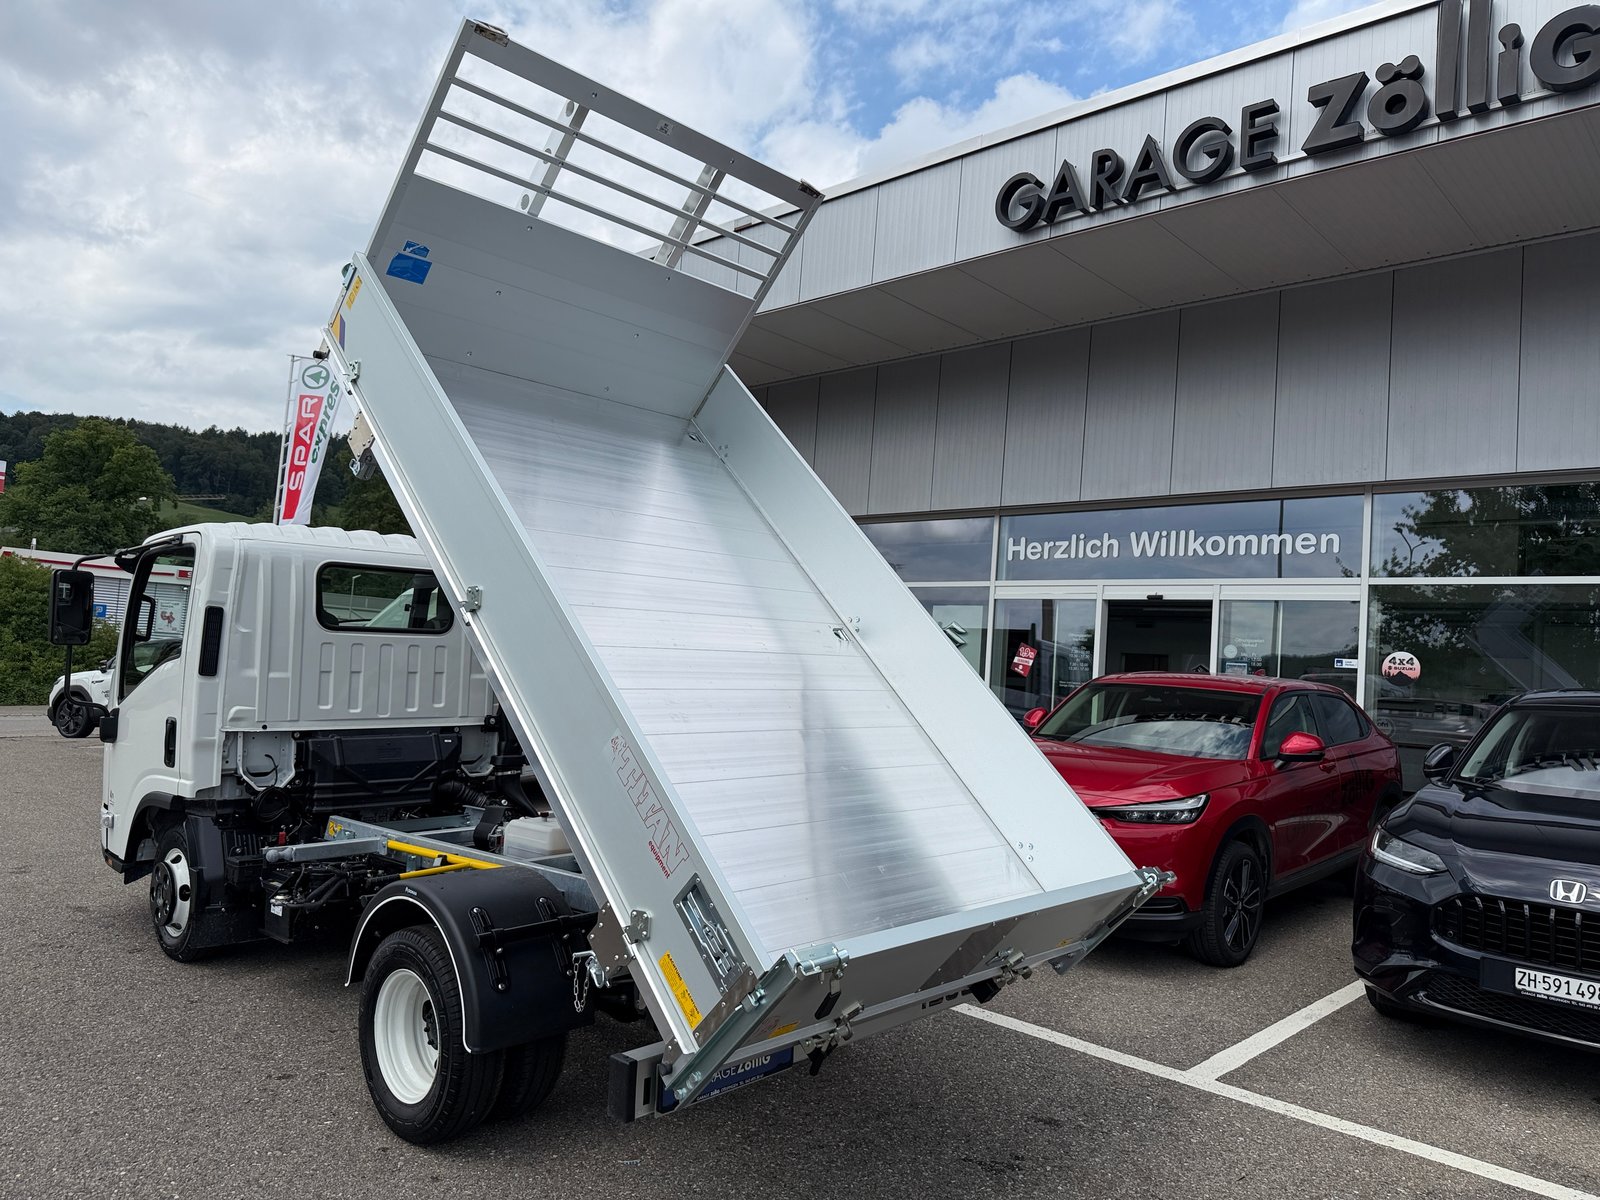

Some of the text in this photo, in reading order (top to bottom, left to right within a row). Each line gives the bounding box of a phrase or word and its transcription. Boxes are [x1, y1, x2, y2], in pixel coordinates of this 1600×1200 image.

[995, 98, 1279, 232] GARAGE
[311, 375, 341, 464] expres
[288, 397, 319, 491] SPAR
[1007, 529, 1340, 561] Herzlich Willkommen
[1388, 656, 1415, 666] 4x4
[648, 840, 670, 879] equipment
[1576, 982, 1600, 1001] 49
